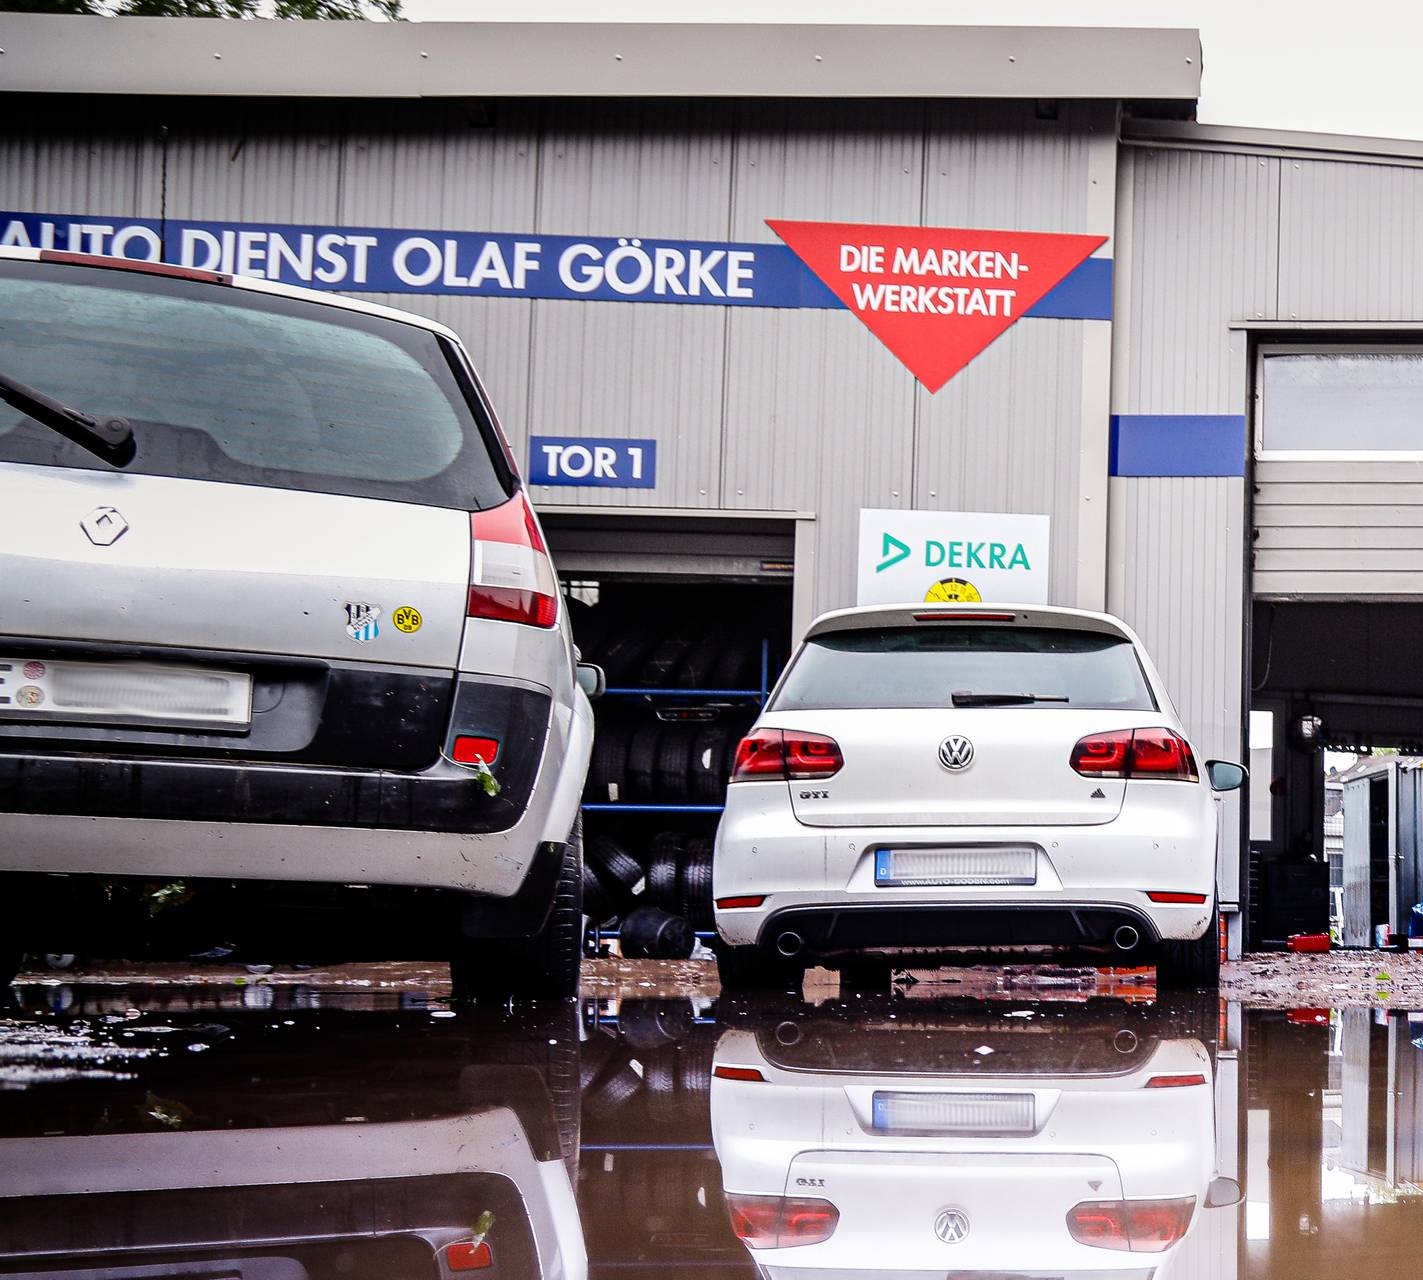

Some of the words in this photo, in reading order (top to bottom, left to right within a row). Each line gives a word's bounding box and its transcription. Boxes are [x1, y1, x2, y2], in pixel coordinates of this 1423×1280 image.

[1, 220, 162, 262] AUTO
[181, 229, 378, 283] DIENST
[393, 237, 541, 289] OLAF
[558, 238, 755, 298] GÖRKE
[840, 244, 884, 274] DIE
[892, 247, 1028, 280] MARKEN-
[852, 283, 1016, 317] WERKSTATT
[542, 444, 618, 479] TOR
[628, 447, 643, 479] 1
[925, 540, 1031, 570] DEKRA
[397, 609, 419, 626] BVB
